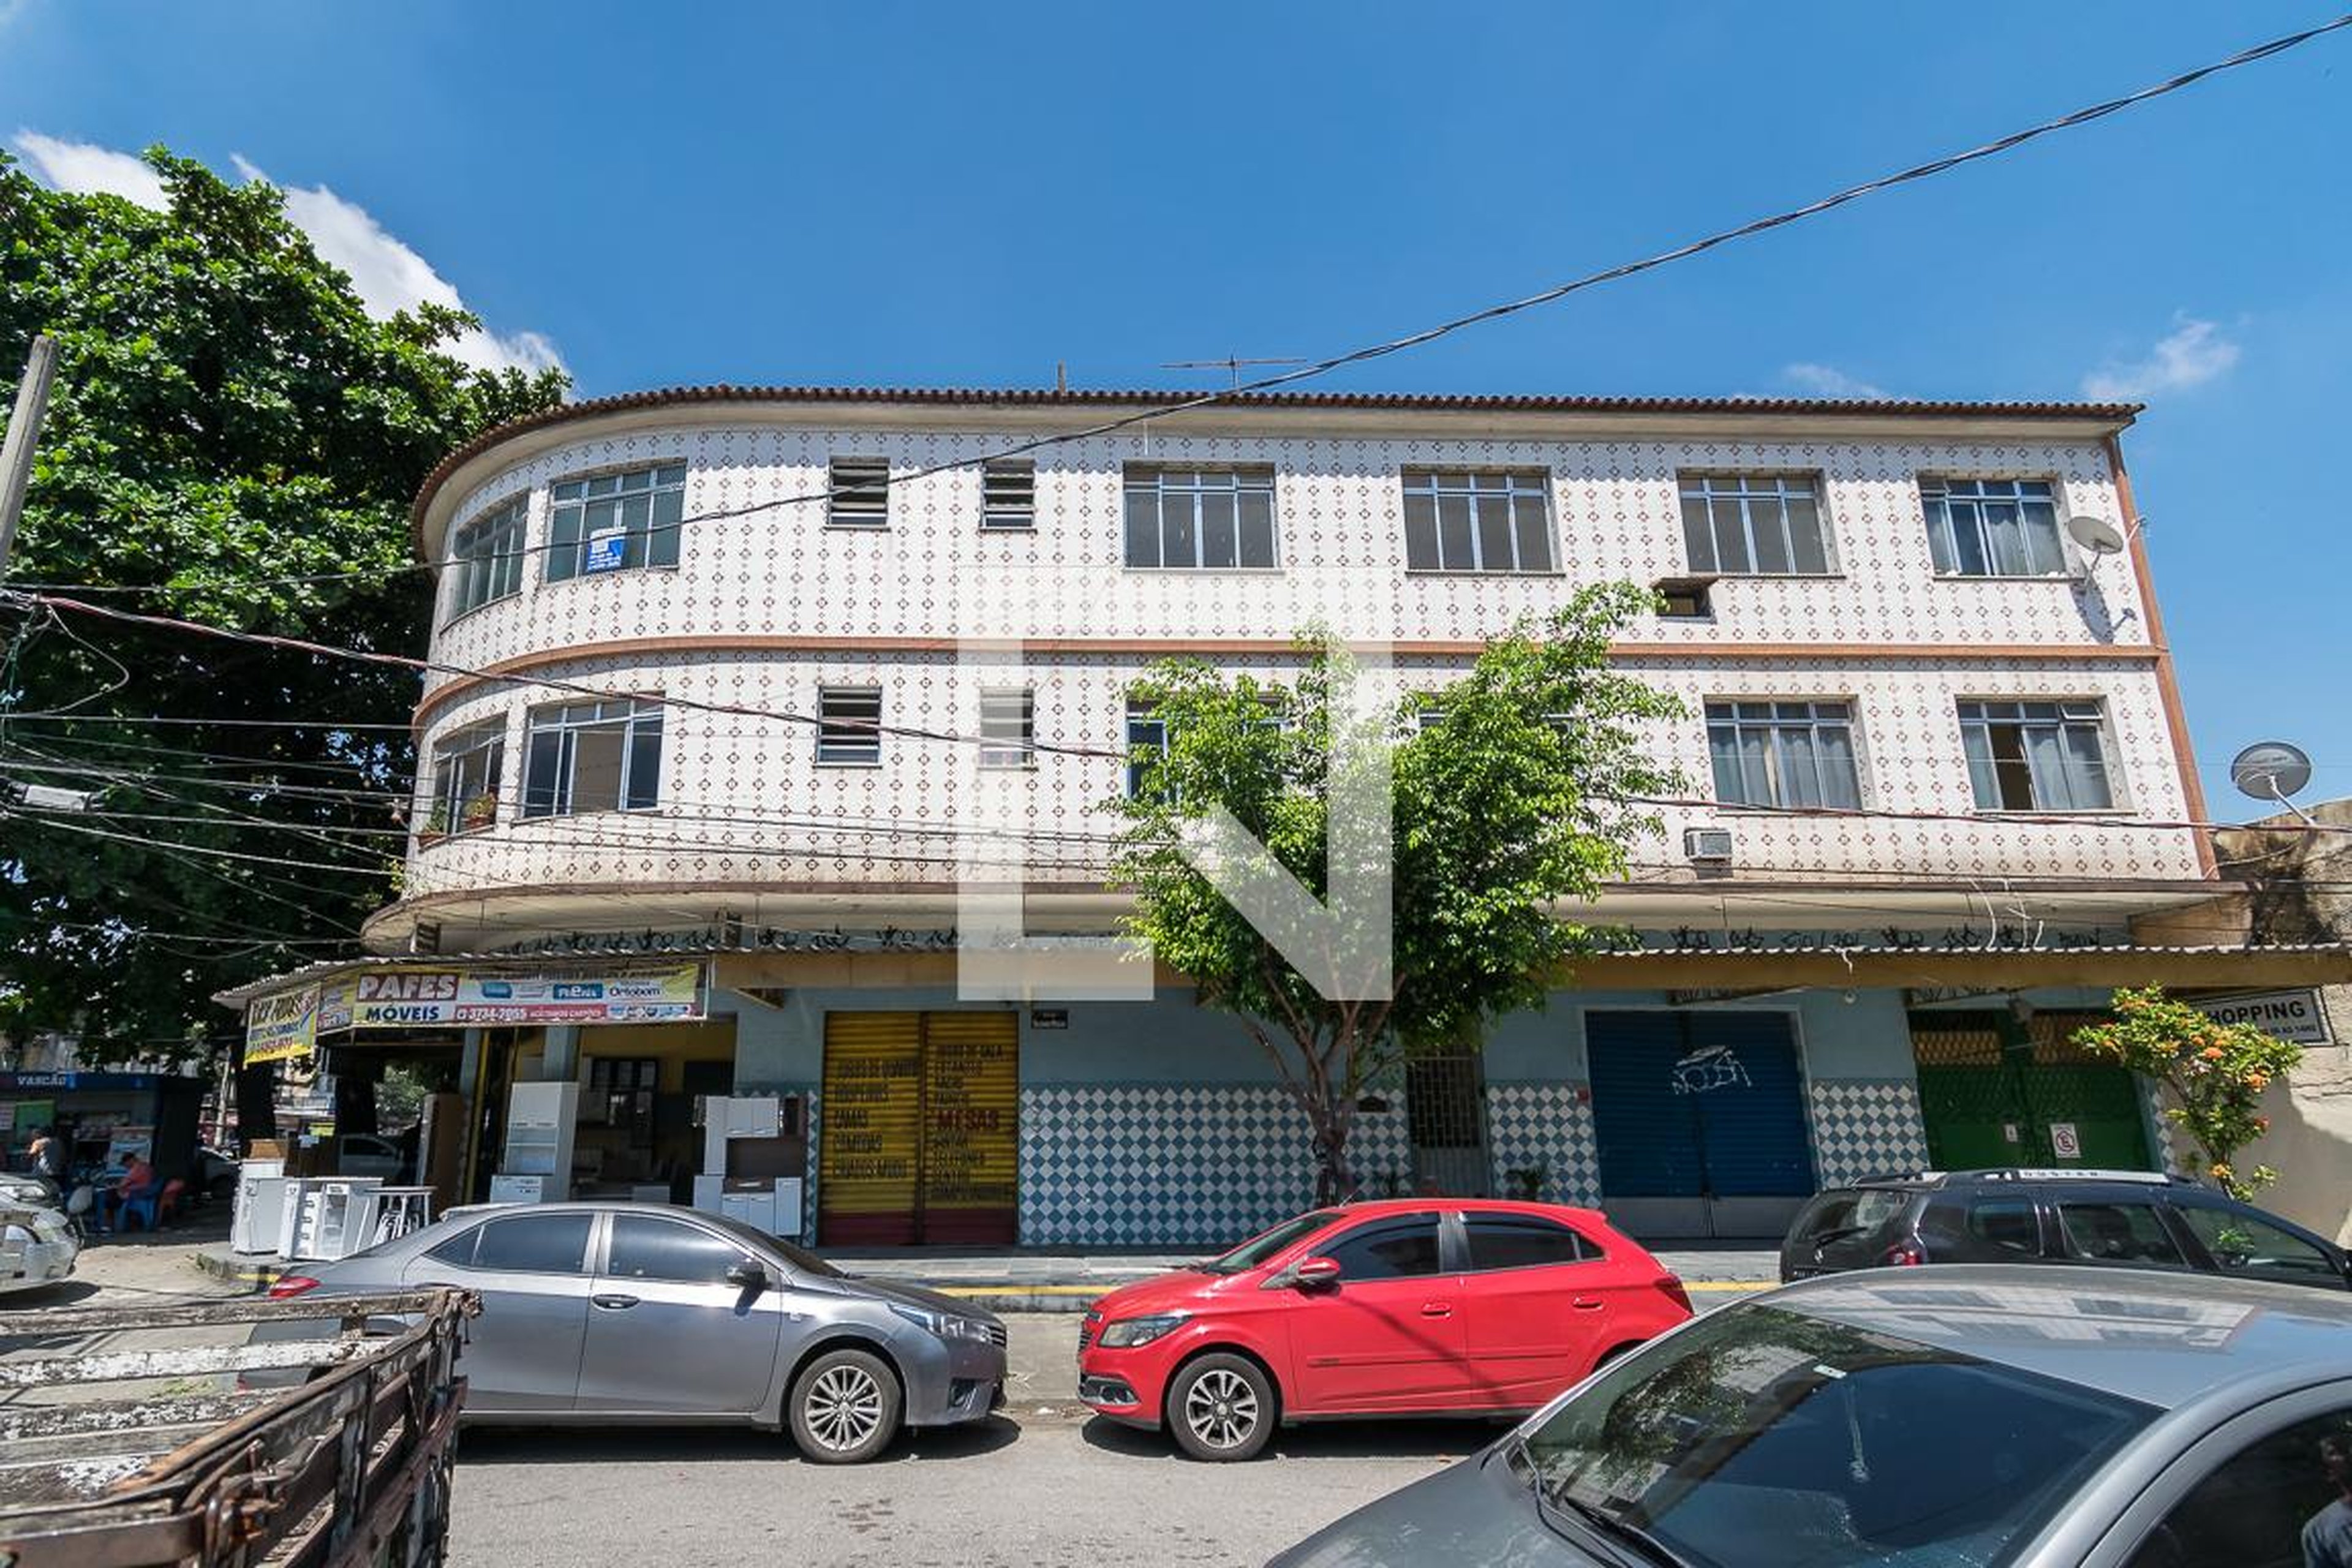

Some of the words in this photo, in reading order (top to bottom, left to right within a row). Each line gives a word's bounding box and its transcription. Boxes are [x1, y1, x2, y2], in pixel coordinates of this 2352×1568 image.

[358, 975, 455, 1000] PAFES
[610, 987, 660, 997] Ortobom
[366, 1003, 439, 1021] MÓVEIS
[2203, 1001, 2305, 1026] HOPPING
[938, 1109, 1000, 1131] MESAS
